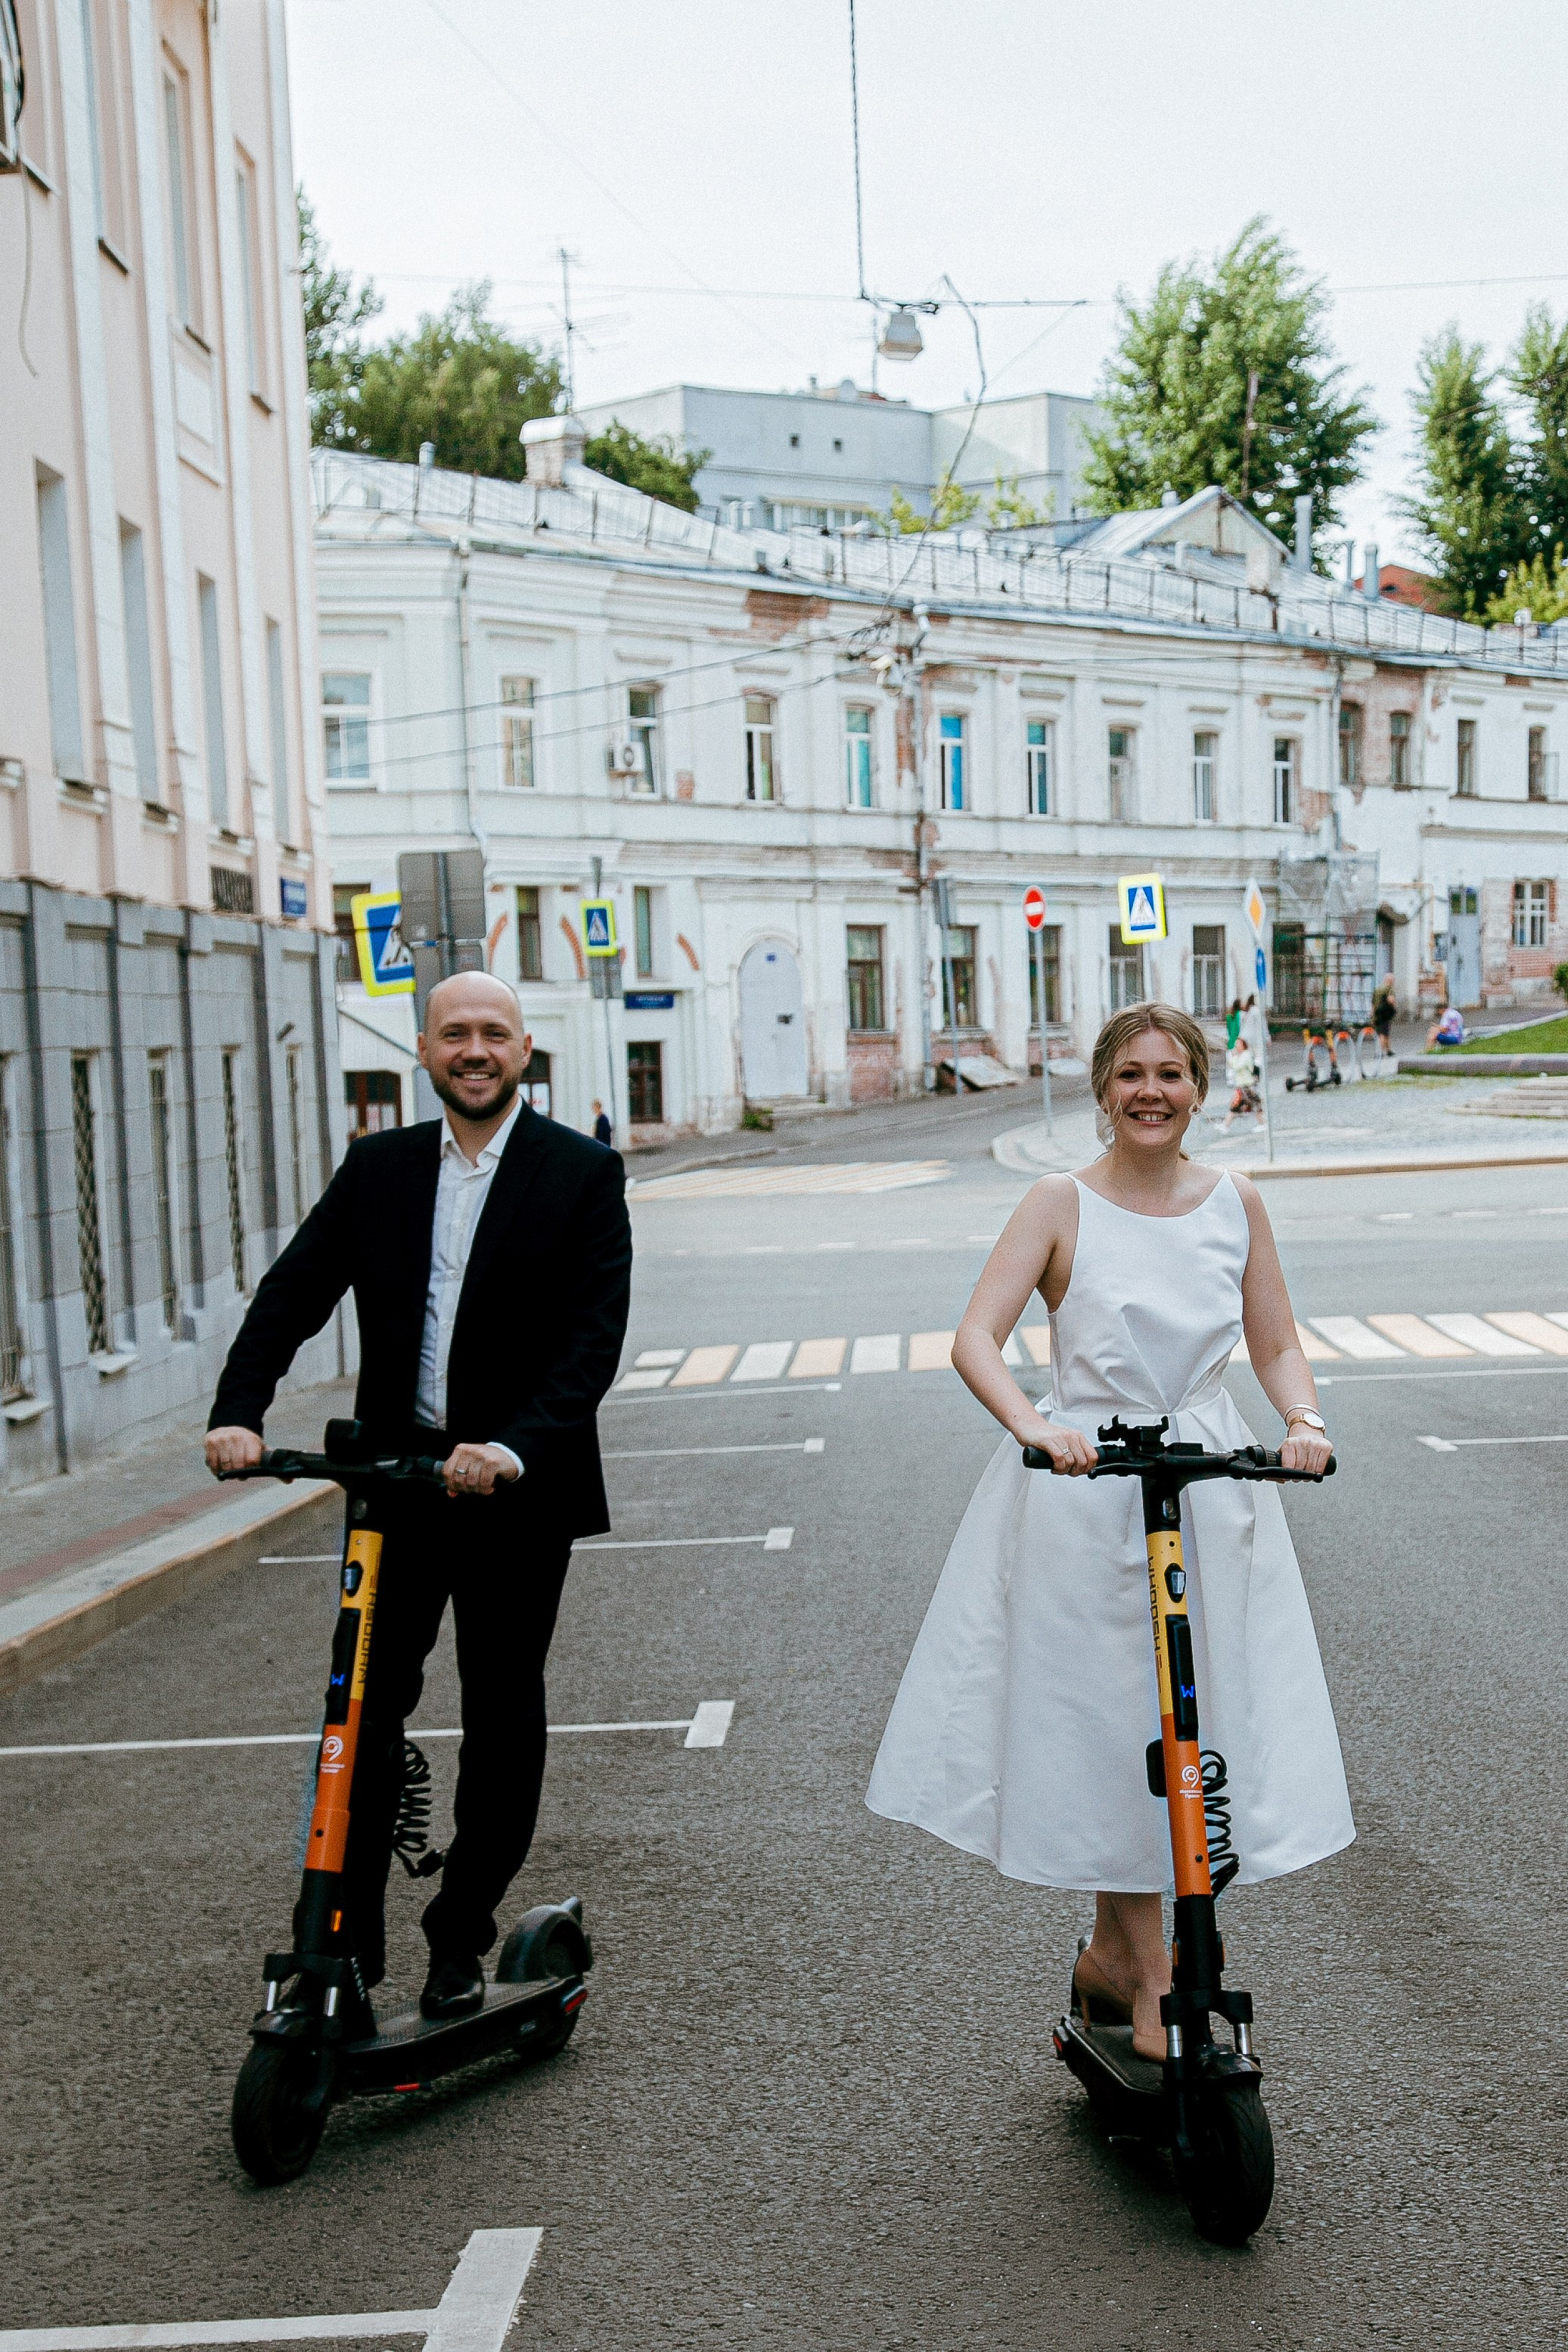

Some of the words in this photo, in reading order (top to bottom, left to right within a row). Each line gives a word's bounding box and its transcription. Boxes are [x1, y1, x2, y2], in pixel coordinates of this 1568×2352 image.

[1147, 1555, 1161, 1652] WHOOSH
[331, 1673, 346, 1686] W
[1181, 1685, 1195, 1698] W
